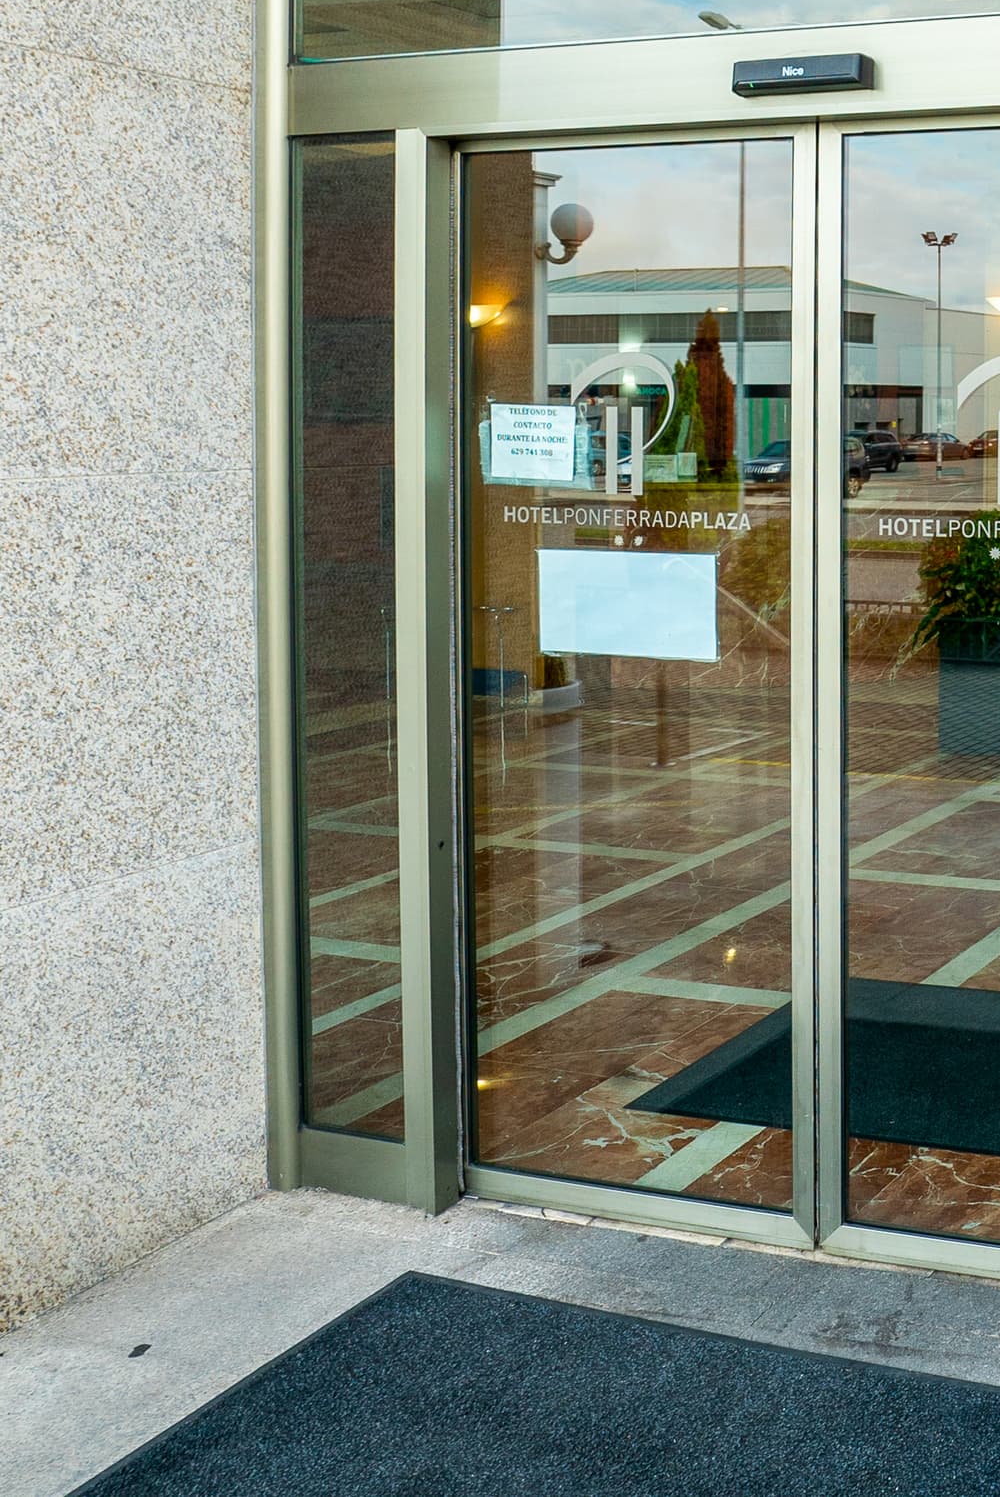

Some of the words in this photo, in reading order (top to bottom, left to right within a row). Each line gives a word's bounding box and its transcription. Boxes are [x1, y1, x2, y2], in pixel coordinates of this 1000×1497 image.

[782, 65, 804, 77] Nice
[513, 422, 552, 430] CONTACTO
[497, 434, 530, 442] DURANTE
[531, 434, 541, 442] LA
